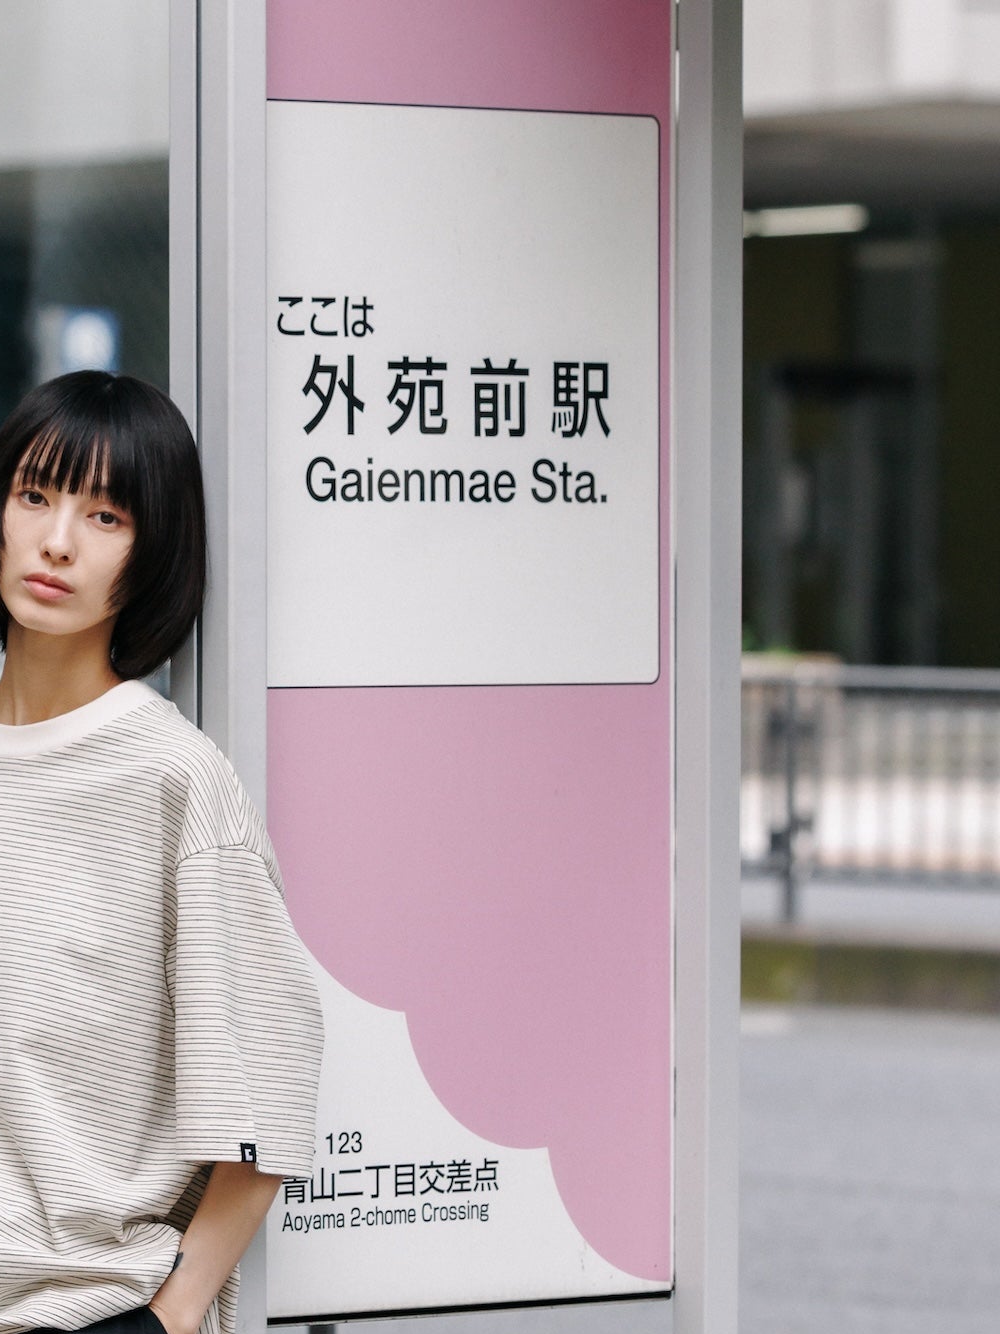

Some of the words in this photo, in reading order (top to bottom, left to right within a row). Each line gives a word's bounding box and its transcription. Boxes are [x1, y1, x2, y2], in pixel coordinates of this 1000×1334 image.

[276, 296, 375, 338] ここは
[301, 354, 611, 439] 外苑前駅
[305, 456, 517, 504] Gaienmae
[530, 458, 608, 504] Sta.
[325, 1130, 363, 1155] 123
[281, 1158, 500, 1205] 青山二丁目交差点
[281, 1212, 345, 1234] Aoyama
[350, 1206, 417, 1227] 2-chome
[421, 1200, 489, 1223] Crossing
